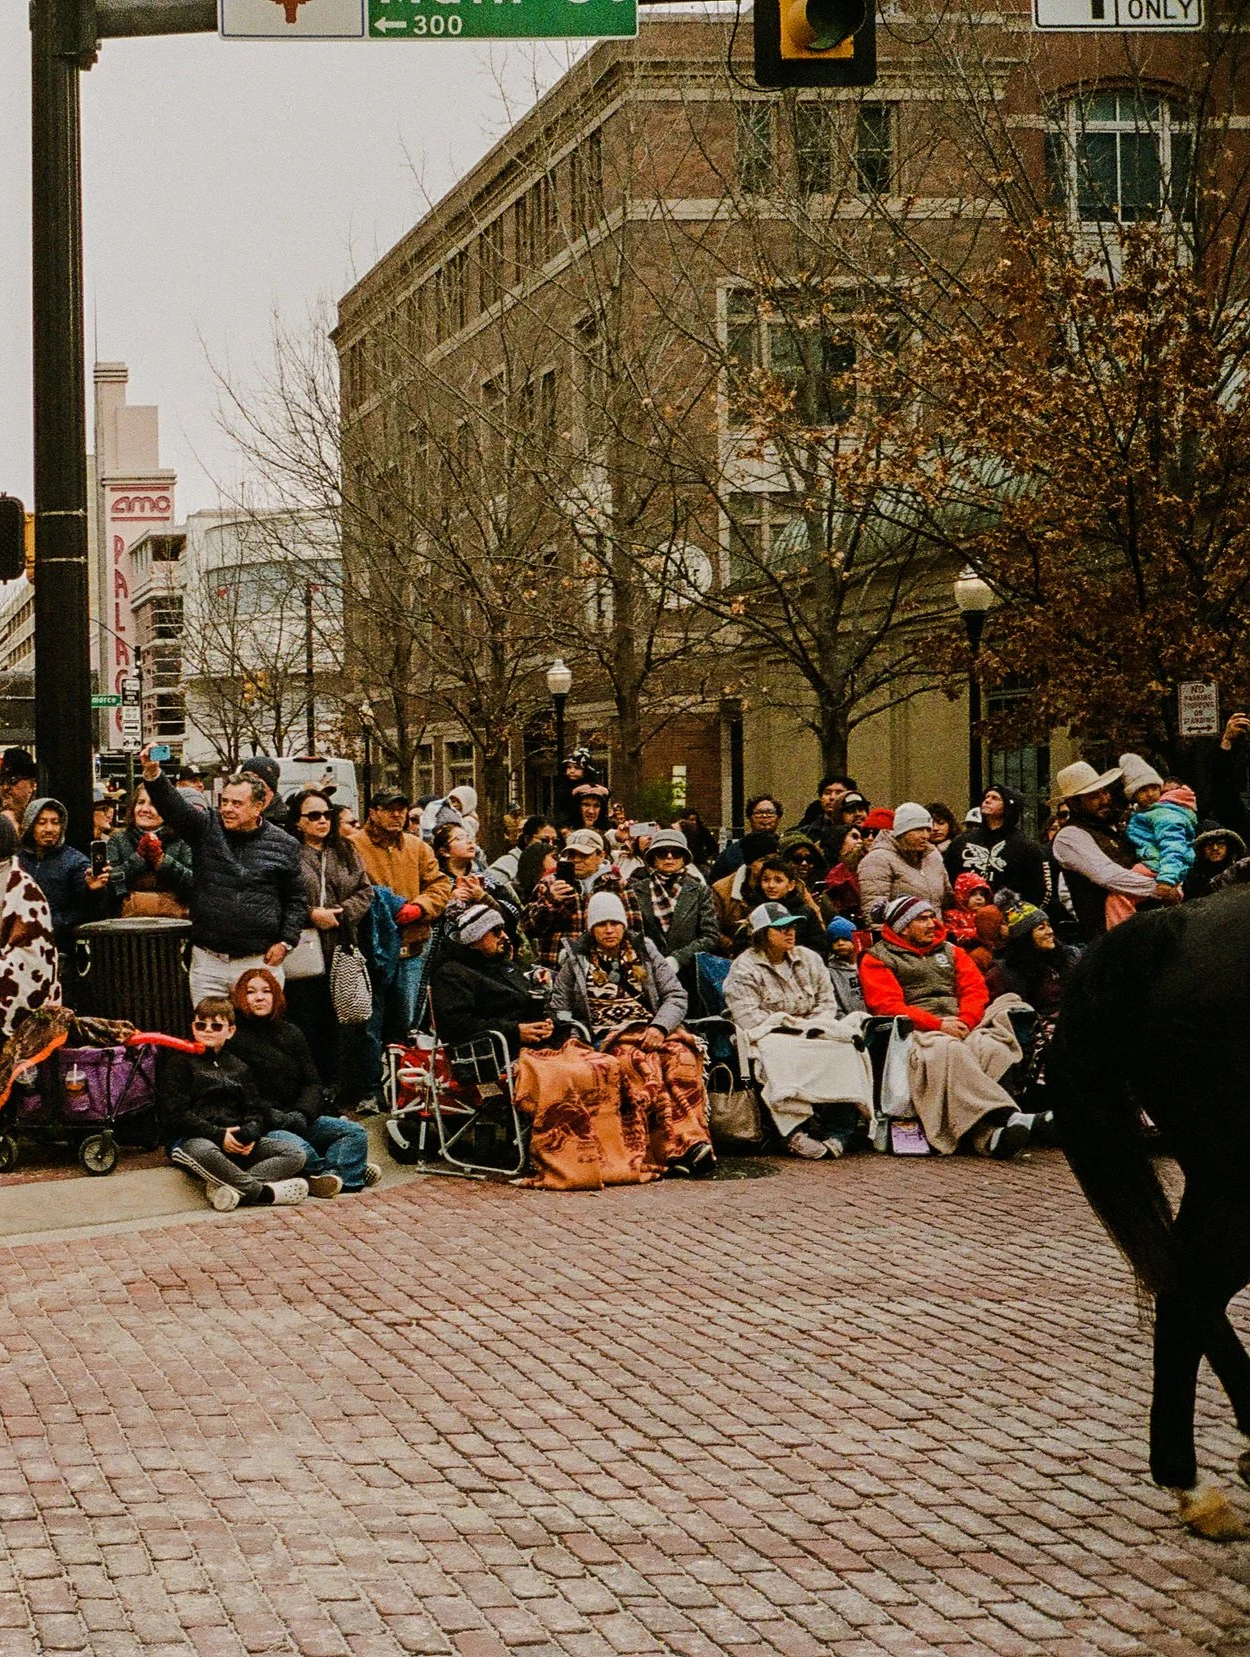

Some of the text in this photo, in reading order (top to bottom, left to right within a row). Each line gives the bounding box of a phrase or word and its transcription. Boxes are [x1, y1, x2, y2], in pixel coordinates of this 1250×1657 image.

[1127, 0, 1193, 20] ONLY
[413, 15, 463, 35] 300
[91, 696, 117, 704] merce
